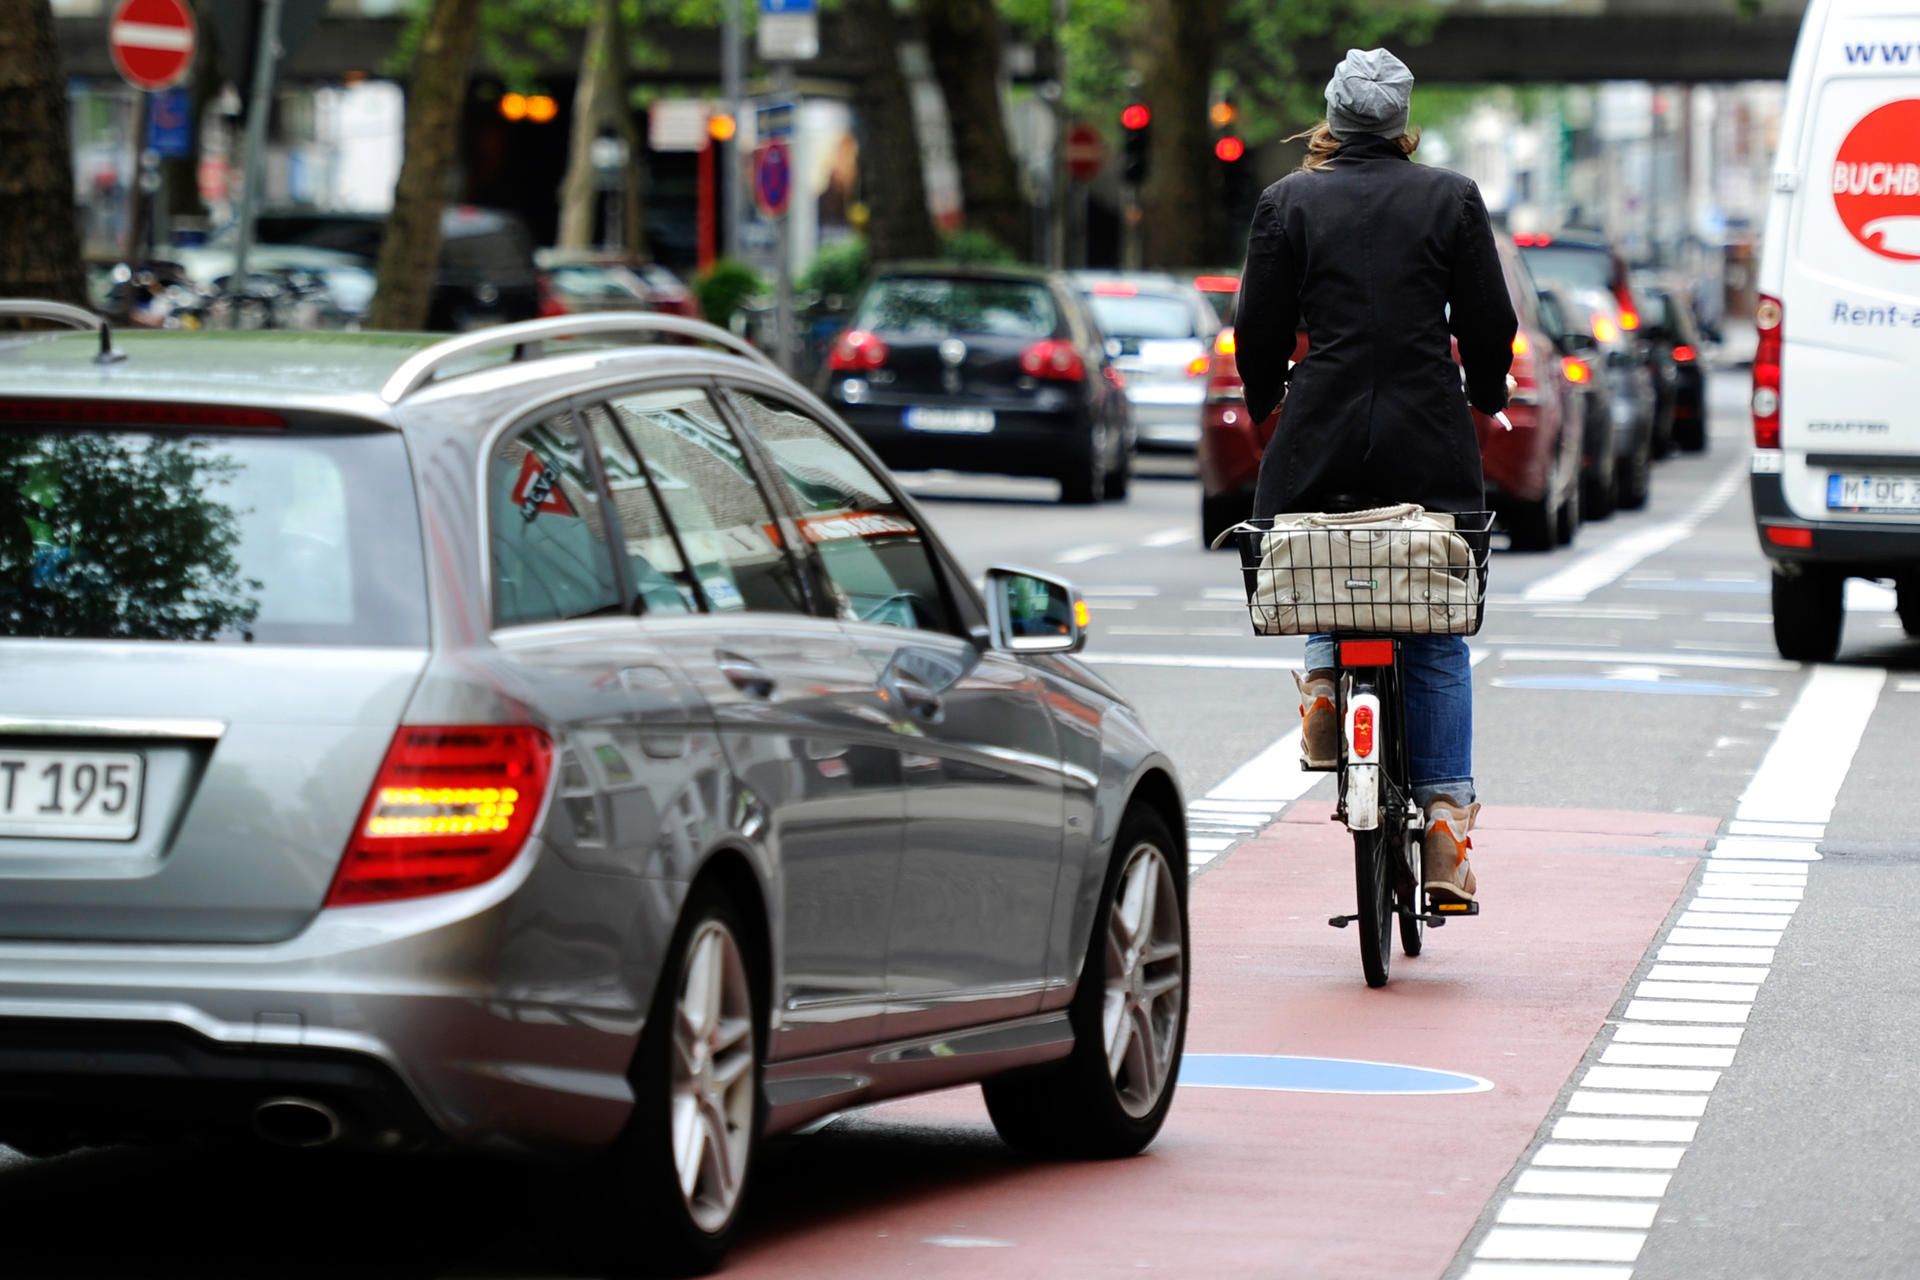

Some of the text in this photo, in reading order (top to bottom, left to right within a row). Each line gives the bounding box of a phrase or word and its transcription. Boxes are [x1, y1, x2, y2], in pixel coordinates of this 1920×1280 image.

[1845, 43, 1920, 64] ww
[1833, 161, 1920, 196] BUCHB
[1808, 421, 1889, 433] CRAFTER
[1844, 481, 1859, 502] M
[0, 761, 130, 815] T 195
